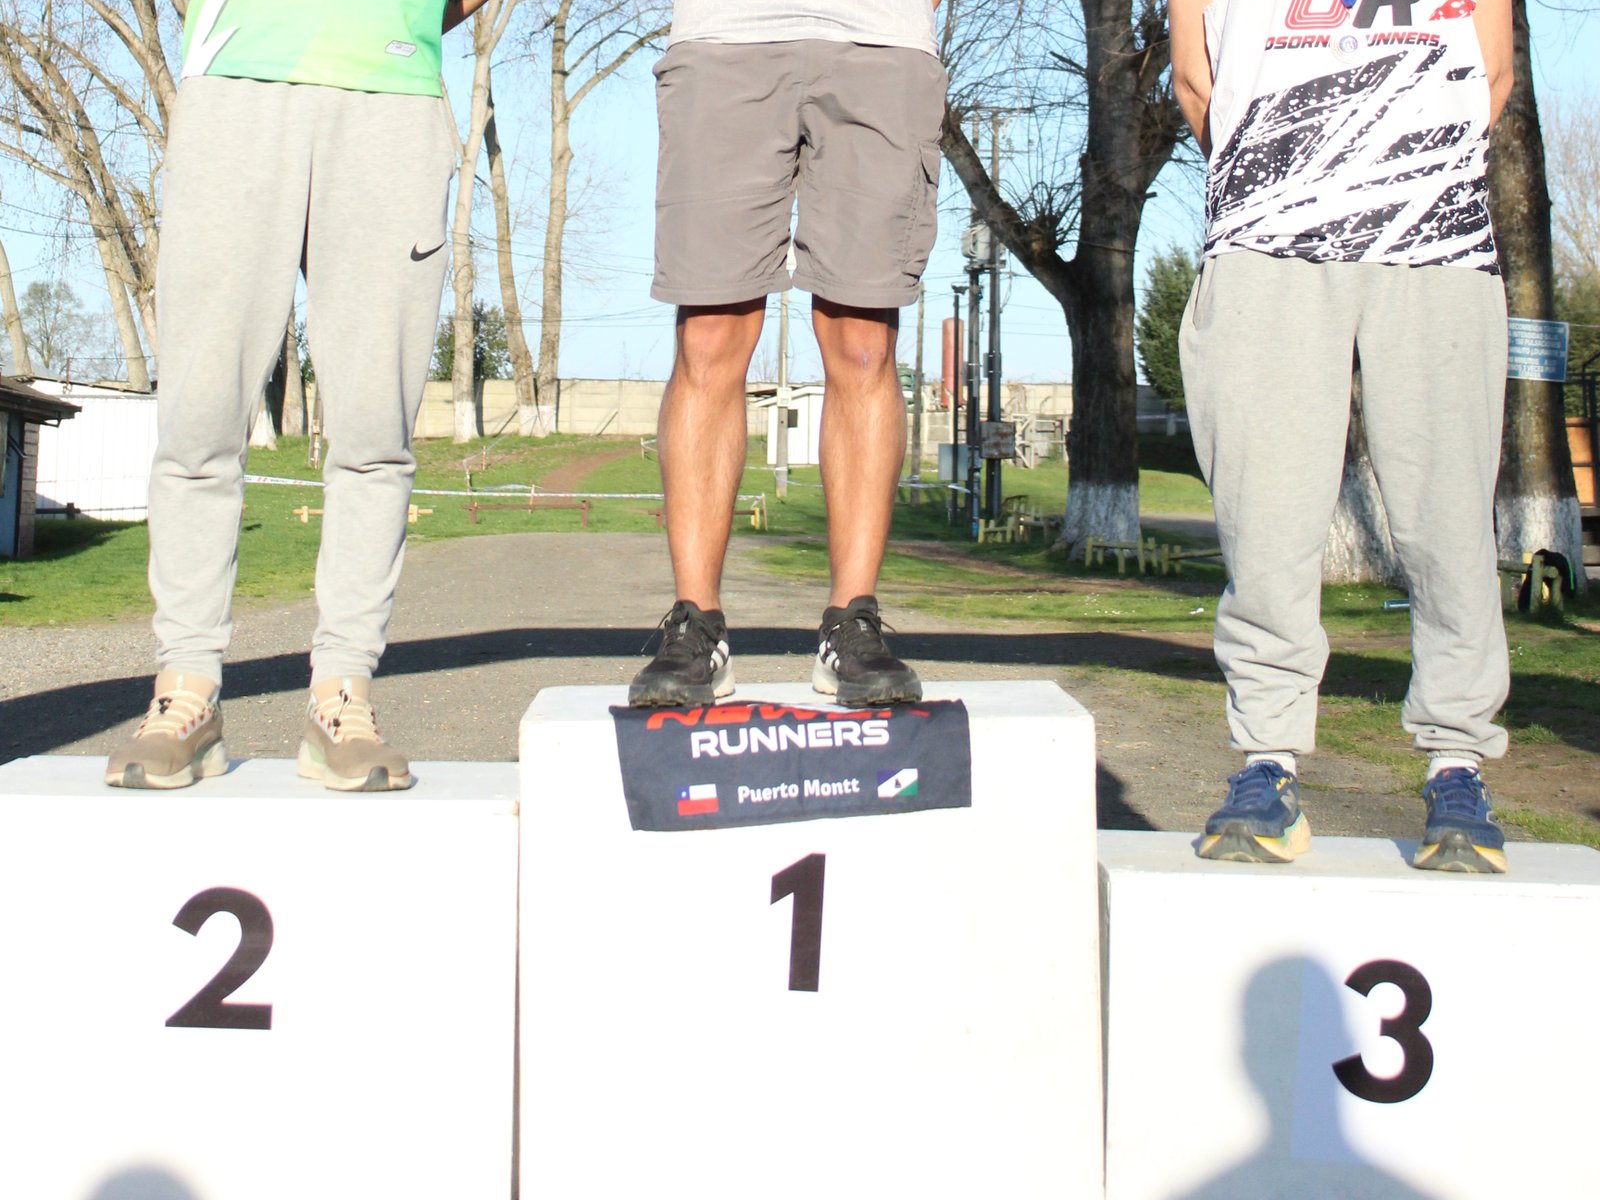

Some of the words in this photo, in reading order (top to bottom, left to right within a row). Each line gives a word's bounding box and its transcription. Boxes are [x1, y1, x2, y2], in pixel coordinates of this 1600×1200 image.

[1264, 34, 1332, 50] OSORN
[690, 719, 890, 760] RUNNERS
[738, 782, 799, 804] Puerto
[803, 777, 861, 798] Montt
[164, 885, 275, 1031] 2
[769, 853, 826, 993] 1
[1331, 958, 1435, 1105] 3
